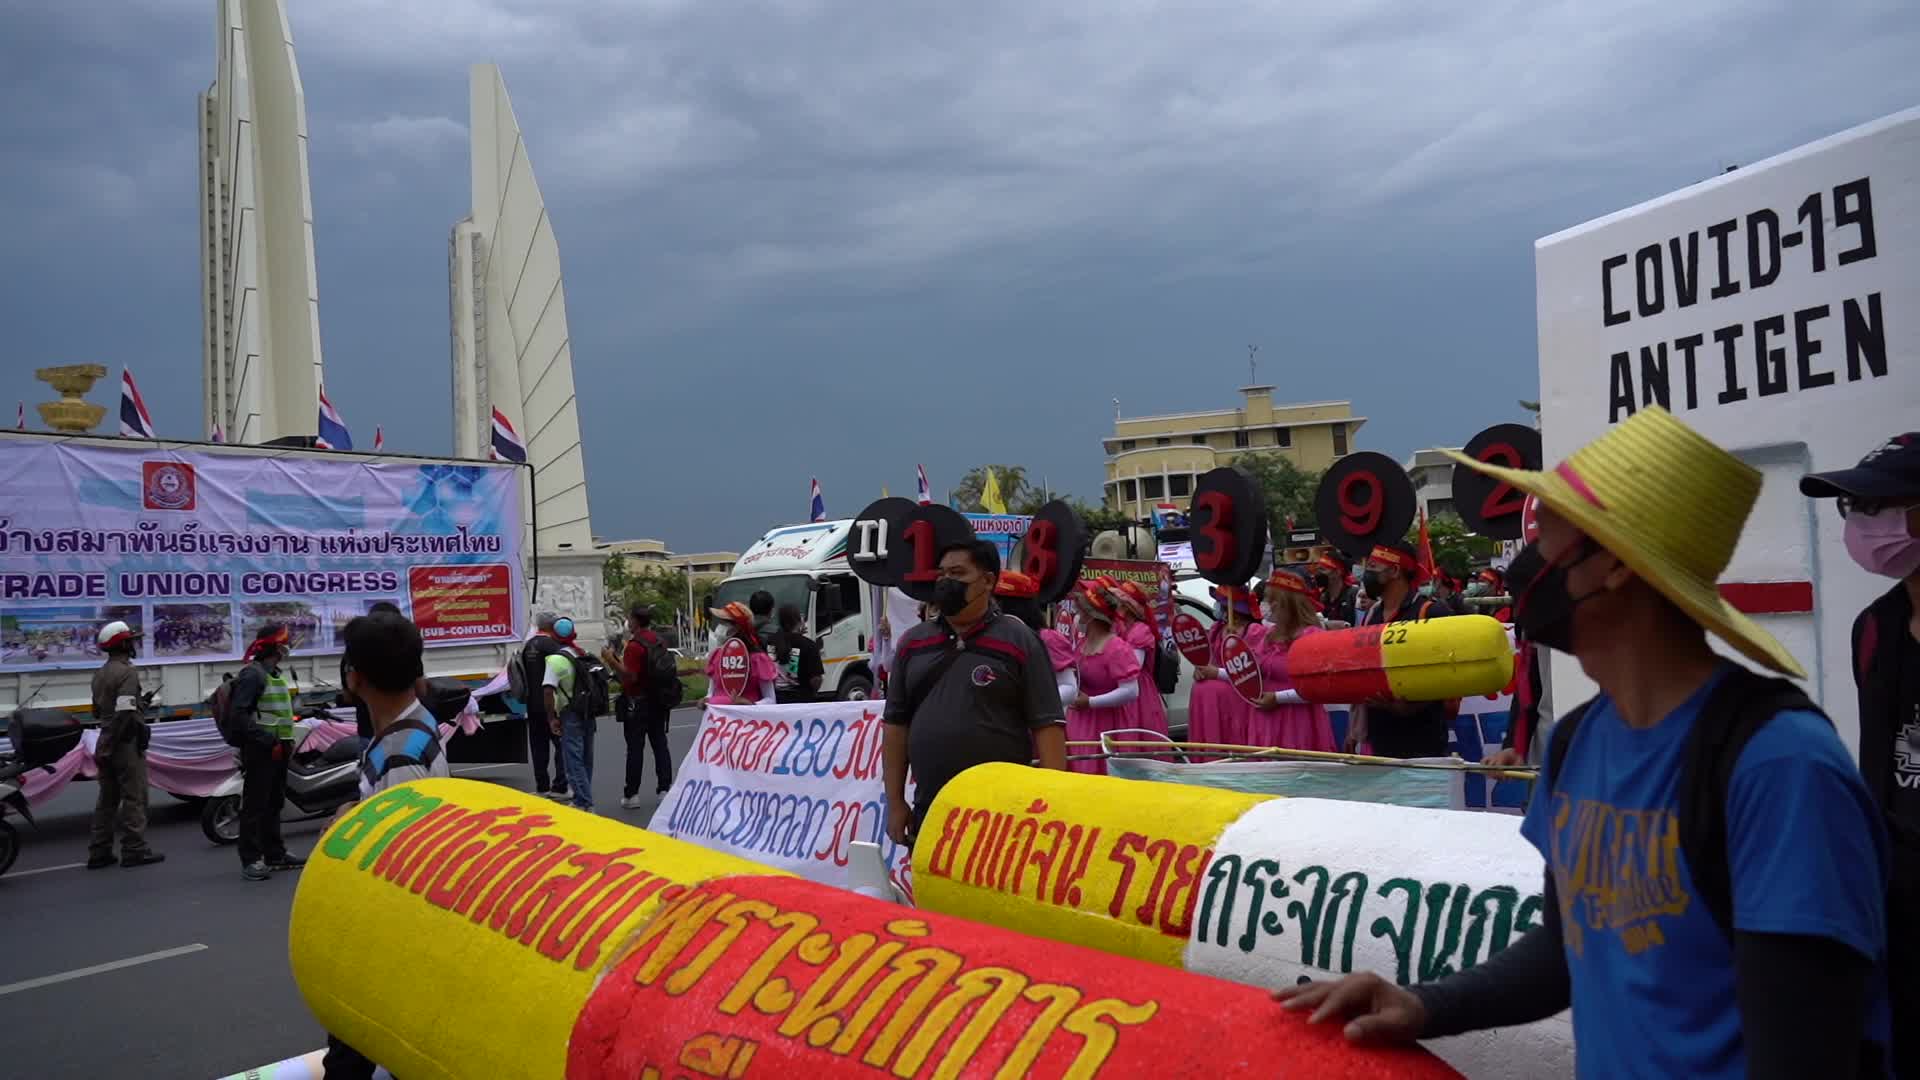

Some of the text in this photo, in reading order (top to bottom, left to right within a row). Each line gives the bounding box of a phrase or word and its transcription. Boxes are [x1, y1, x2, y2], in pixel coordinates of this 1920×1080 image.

[1602, 176, 1877, 328] COVID-19
[1607, 292, 1888, 424] ANTIGEN
[1197, 490, 1234, 570] 3
[1337, 470, 1384, 536] 9
[320, 526, 501, 555] แห่งประเทศไทย
[903, 520, 942, 582] 1
[1021, 519, 1058, 586] 8
[0, 573, 105, 598] RADE
[120, 573, 231, 597] UNION
[242, 572, 398, 595] CONGRESS
[420, 624, 507, 638] (SUB-CONTRACT)
[1175, 627, 1206, 643] 492
[722, 655, 746, 670] 492
[1226, 651, 1254, 674] 492
[928, 798, 1101, 908] ยาแก้จน
